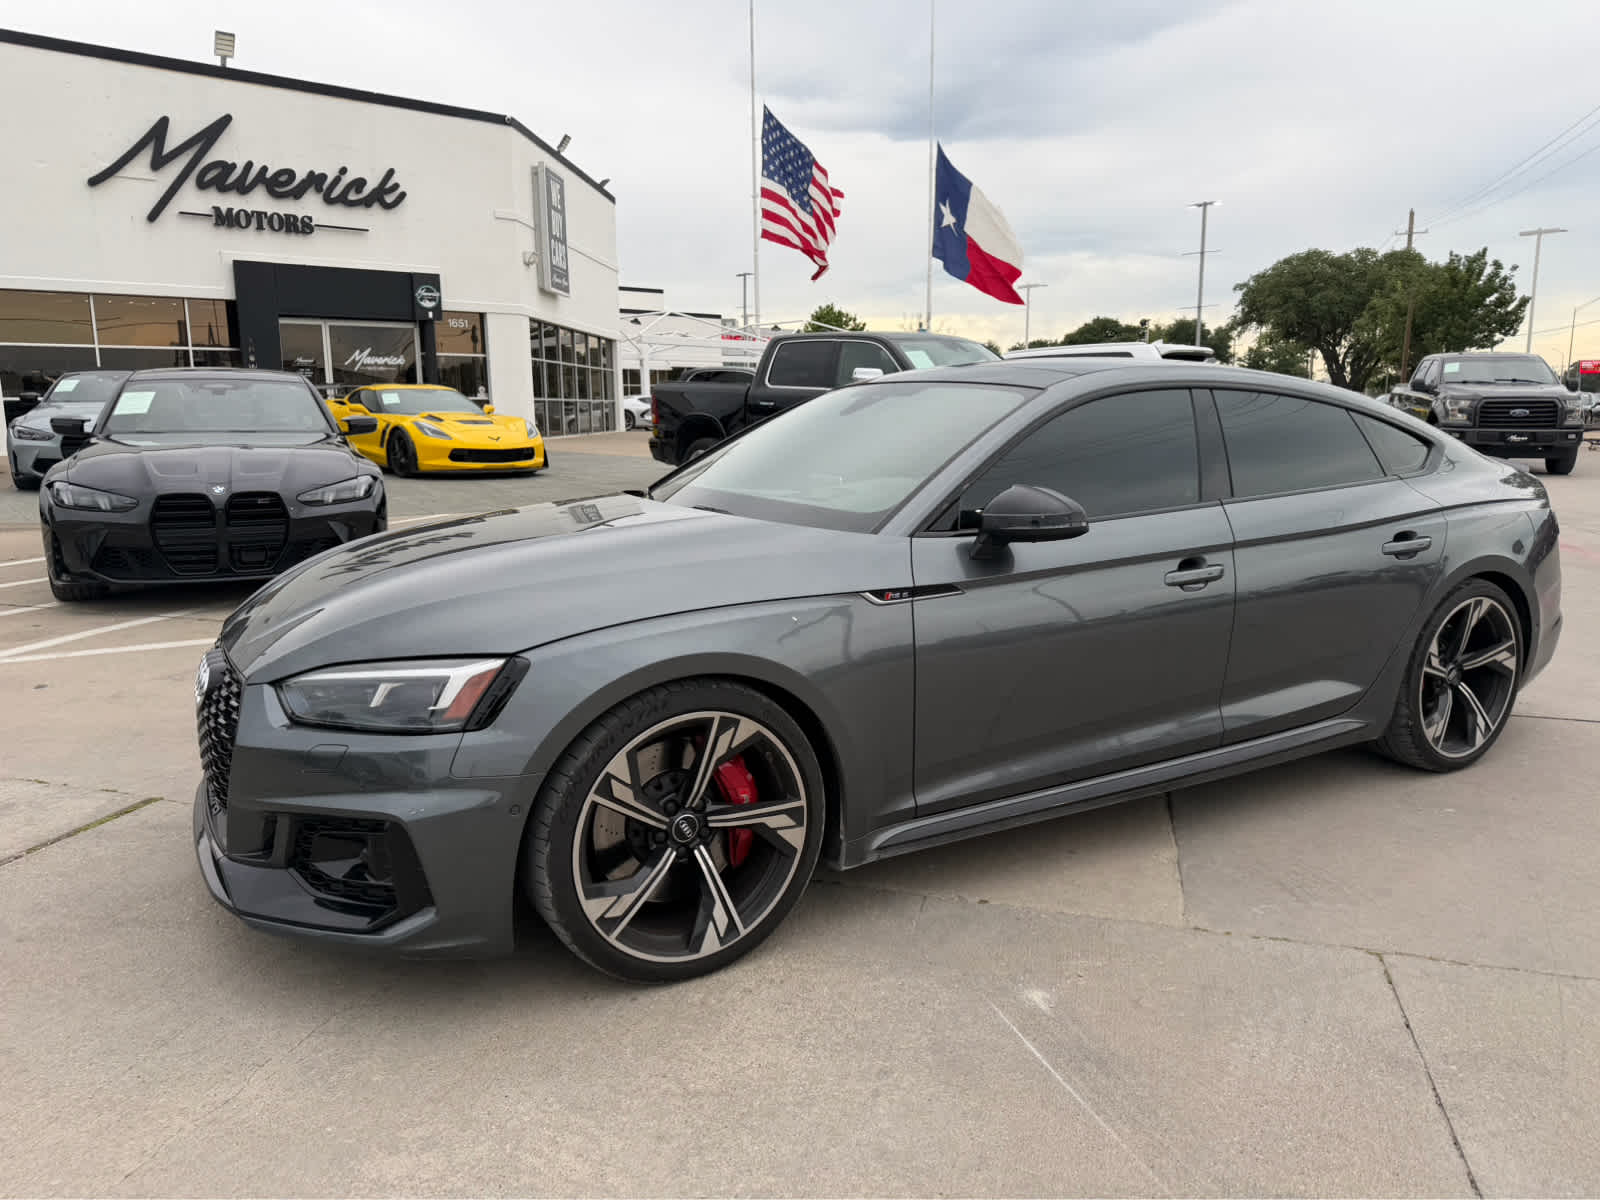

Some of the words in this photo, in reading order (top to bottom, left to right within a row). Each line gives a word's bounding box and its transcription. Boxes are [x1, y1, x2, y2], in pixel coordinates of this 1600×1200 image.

[87, 113, 407, 223] Maverick
[551, 179, 561, 209] WE
[212, 206, 315, 235] MOTORS
[551, 208, 563, 241] BUY
[551, 238, 567, 270] CARS
[447, 318, 469, 329] 1651
[344, 346, 406, 372] Maverick
